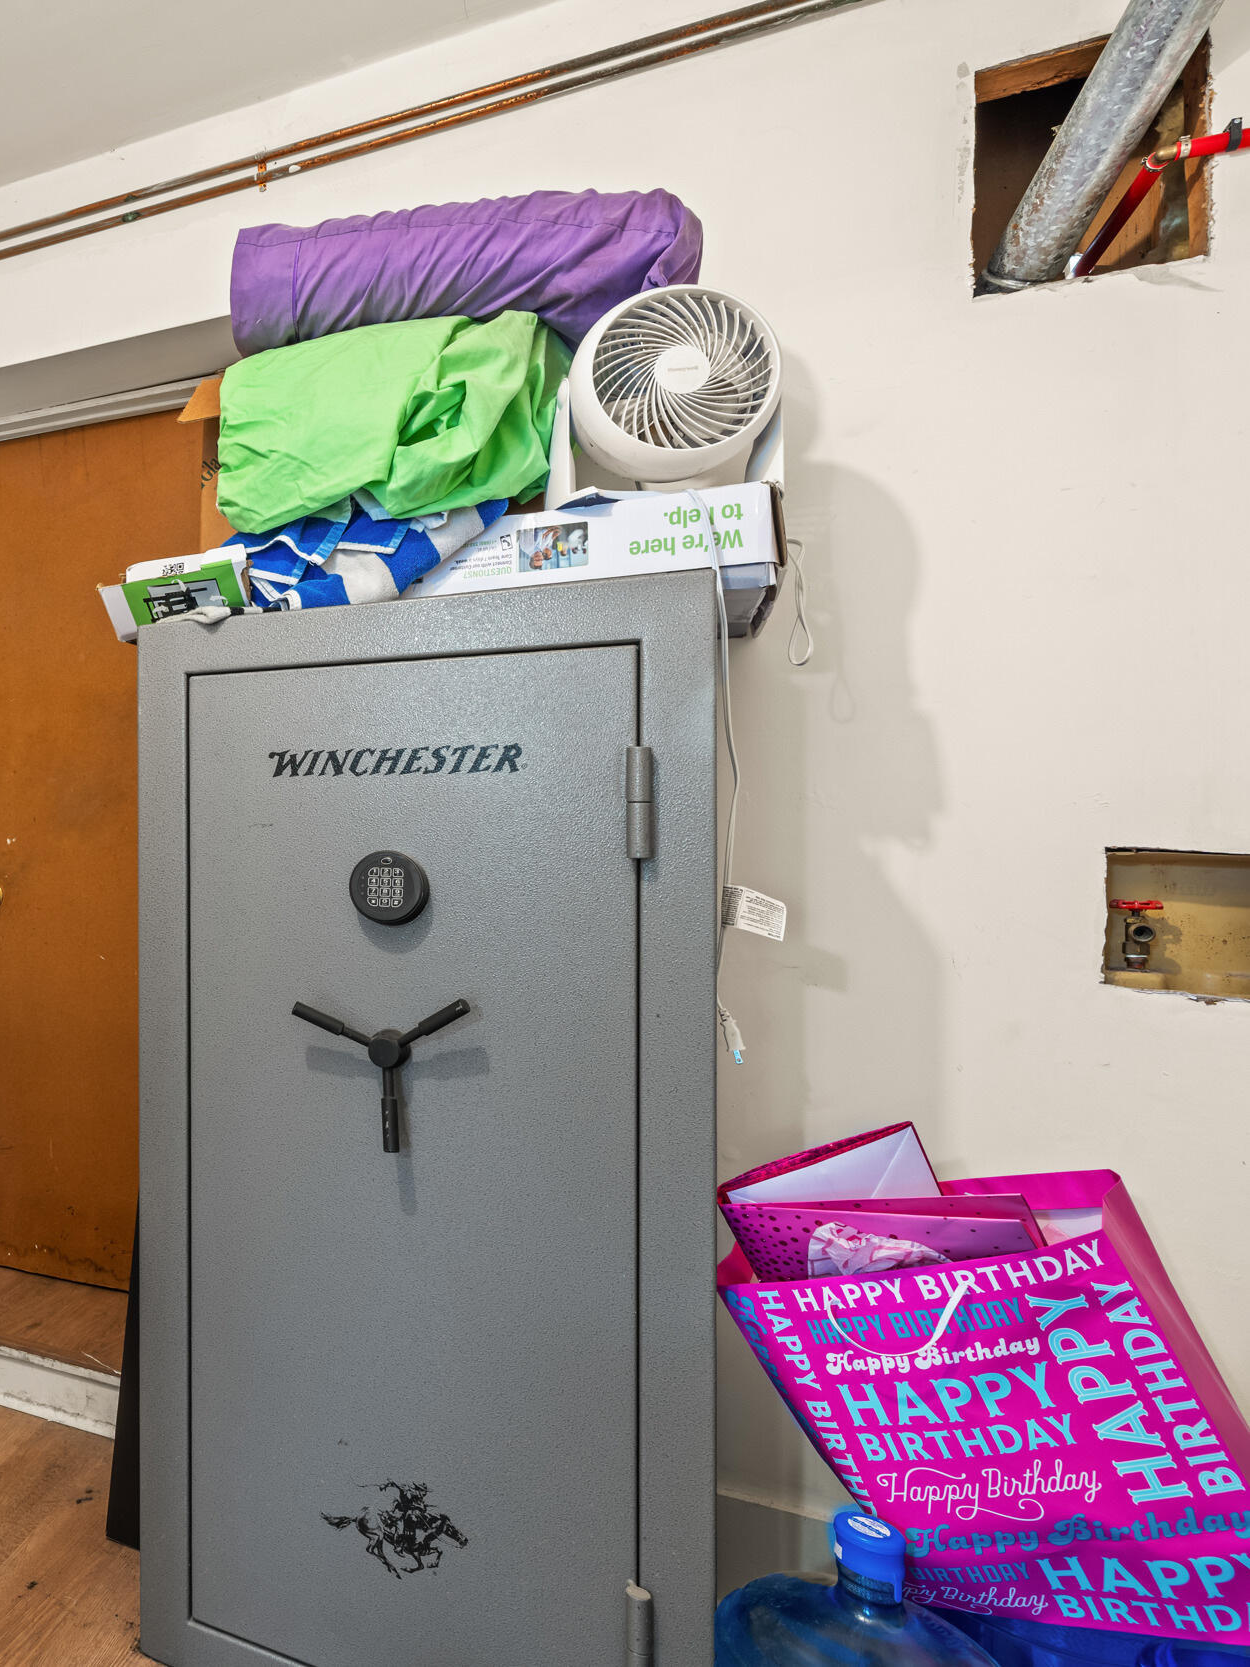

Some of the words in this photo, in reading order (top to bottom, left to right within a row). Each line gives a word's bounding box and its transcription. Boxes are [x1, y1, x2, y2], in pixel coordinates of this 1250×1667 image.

[721, 503, 744, 521] to
[628, 536, 676, 557] here
[682, 528, 744, 553] We're
[268, 742, 523, 778] WINCHESTER
[792, 1277, 905, 1312] HAPPY
[914, 1238, 1105, 1301] BIRTHDAY
[756, 1289, 822, 1391] HAPPY
[806, 1312, 887, 1345] HAPPY
[888, 1297, 1025, 1339] BIRTHDAY
[825, 1350, 911, 1376] Happy
[914, 1336, 1040, 1370] Birthday
[836, 1361, 1057, 1428] HAPPY
[1025, 1293, 1193, 1505] HAPPY
[1090, 1280, 1246, 1496] BIRTHDAY
[855, 1413, 1077, 1462] BIRTHDAY
[876, 1467, 1044, 1521] Happy
[982, 1458, 1102, 1503] Birthday
[905, 1523, 1040, 1558] Happy
[1047, 1506, 1250, 1546] Birthday
[910, 1561, 1031, 1585] BIRTHDAY
[940, 1586, 1049, 1616] Birthday
[1052, 1594, 1250, 1633] BIRTHD
